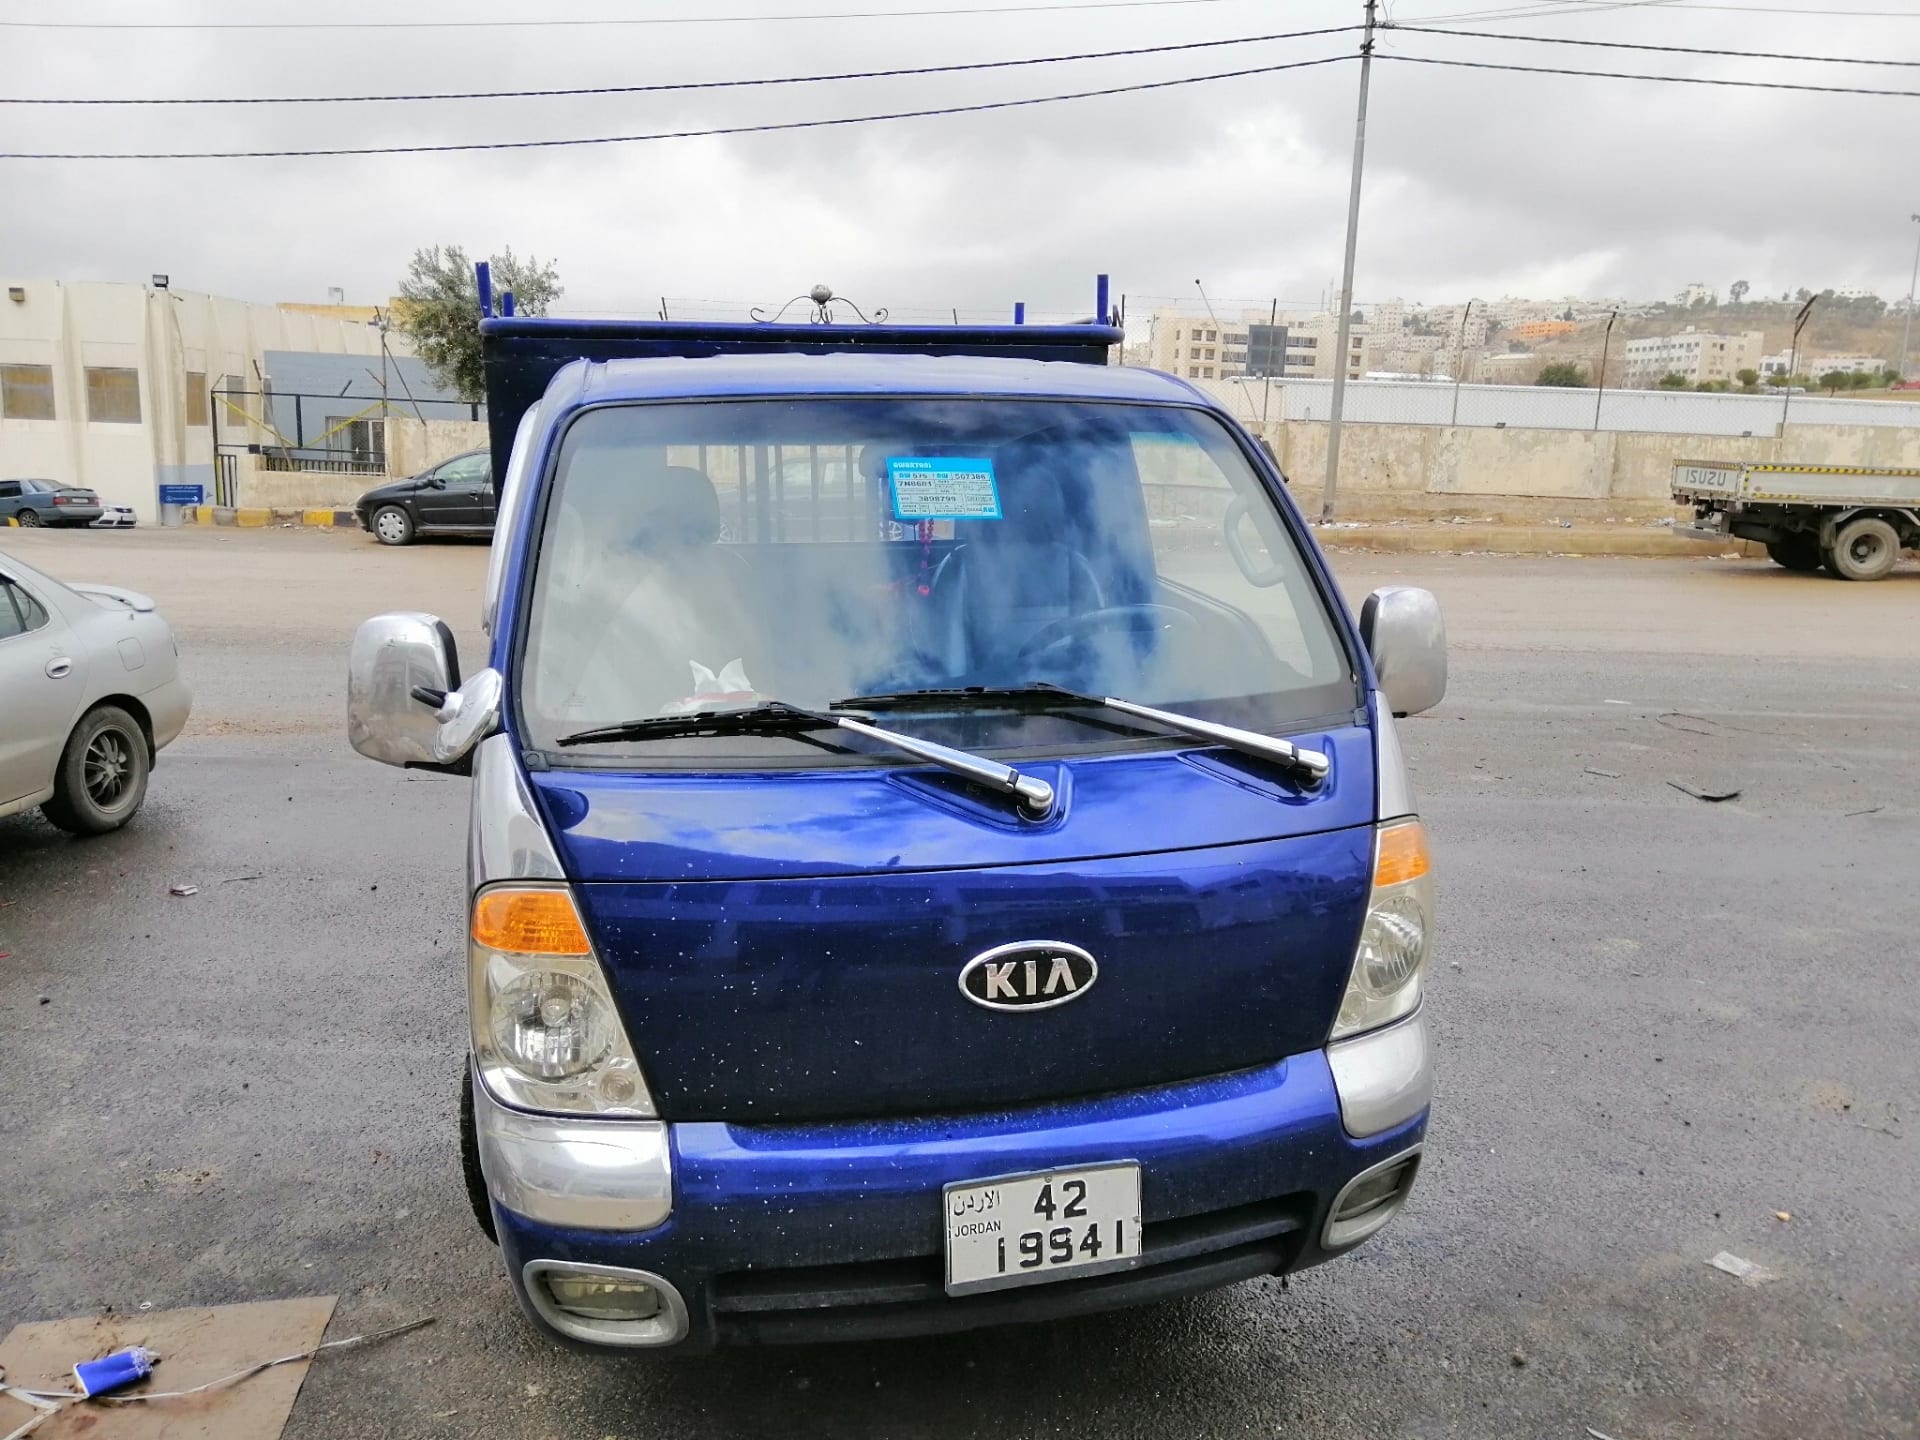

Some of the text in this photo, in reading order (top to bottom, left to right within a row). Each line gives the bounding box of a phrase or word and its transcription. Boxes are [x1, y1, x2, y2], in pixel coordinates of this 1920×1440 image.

[1685, 469, 1727, 487] ISUZU
[985, 957, 1077, 999] KIA
[1034, 1179, 1087, 1221] 42
[954, 1220, 1001, 1238] JORDAN
